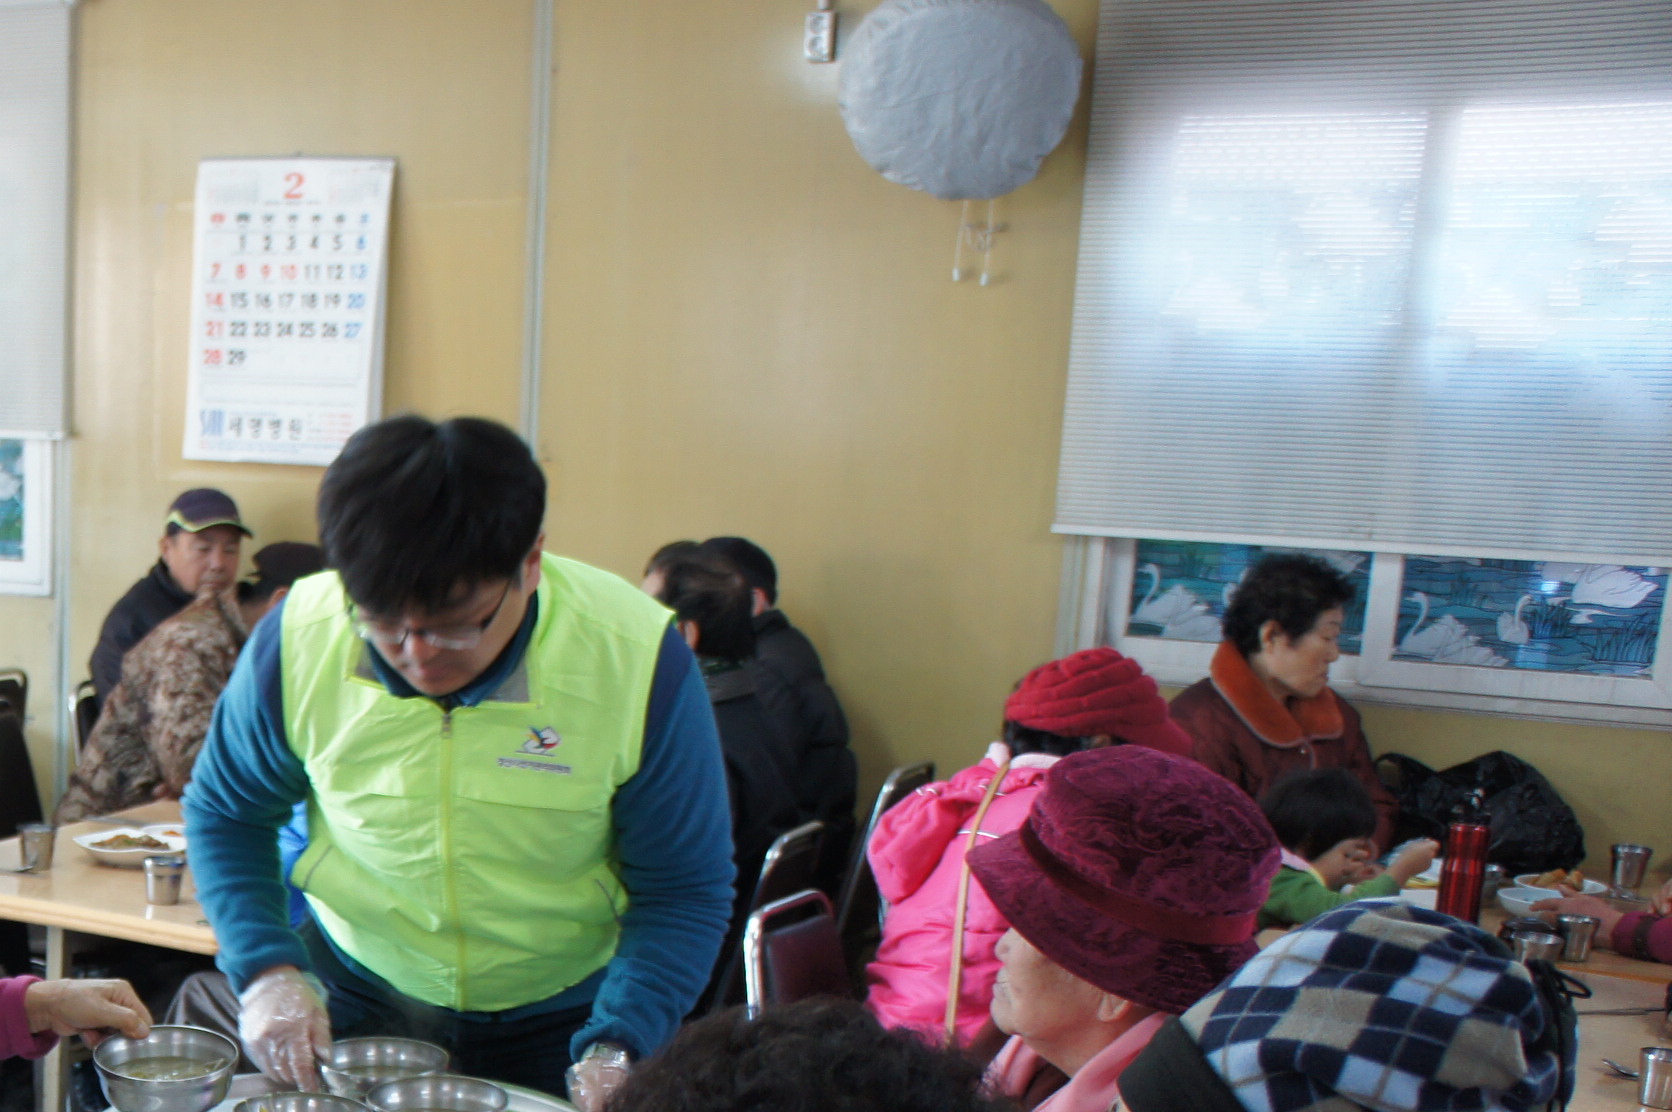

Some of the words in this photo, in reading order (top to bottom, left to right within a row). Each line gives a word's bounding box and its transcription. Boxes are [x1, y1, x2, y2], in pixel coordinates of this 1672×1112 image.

[284, 171, 305, 199] 2
[239, 233, 247, 251] 1
[263, 234, 273, 251] 2
[287, 234, 297, 251] 3
[310, 234, 319, 250] 4
[333, 234, 343, 251] 5
[356, 235, 366, 250] 6
[211, 263, 221, 279] 7
[236, 263, 246, 279] 8
[260, 264, 271, 280] 9
[281, 263, 297, 280] 10
[305, 264, 321, 280] 11
[327, 264, 344, 280] 12
[350, 264, 368, 280] 13
[206, 292, 223, 308] 14
[231, 292, 248, 308] 15
[255, 292, 272, 309] 16
[278, 292, 295, 309] 17
[301, 292, 318, 309] 18
[324, 292, 341, 309] 19
[347, 292, 365, 309] 20
[206, 321, 223, 337] 21
[230, 321, 247, 337] 22
[254, 321, 271, 337] 23
[277, 321, 294, 337] 24
[299, 321, 316, 338] 25
[321, 321, 339, 338] 26
[344, 322, 362, 338] 27
[203, 349, 222, 365] 28
[228, 349, 246, 365] 29
